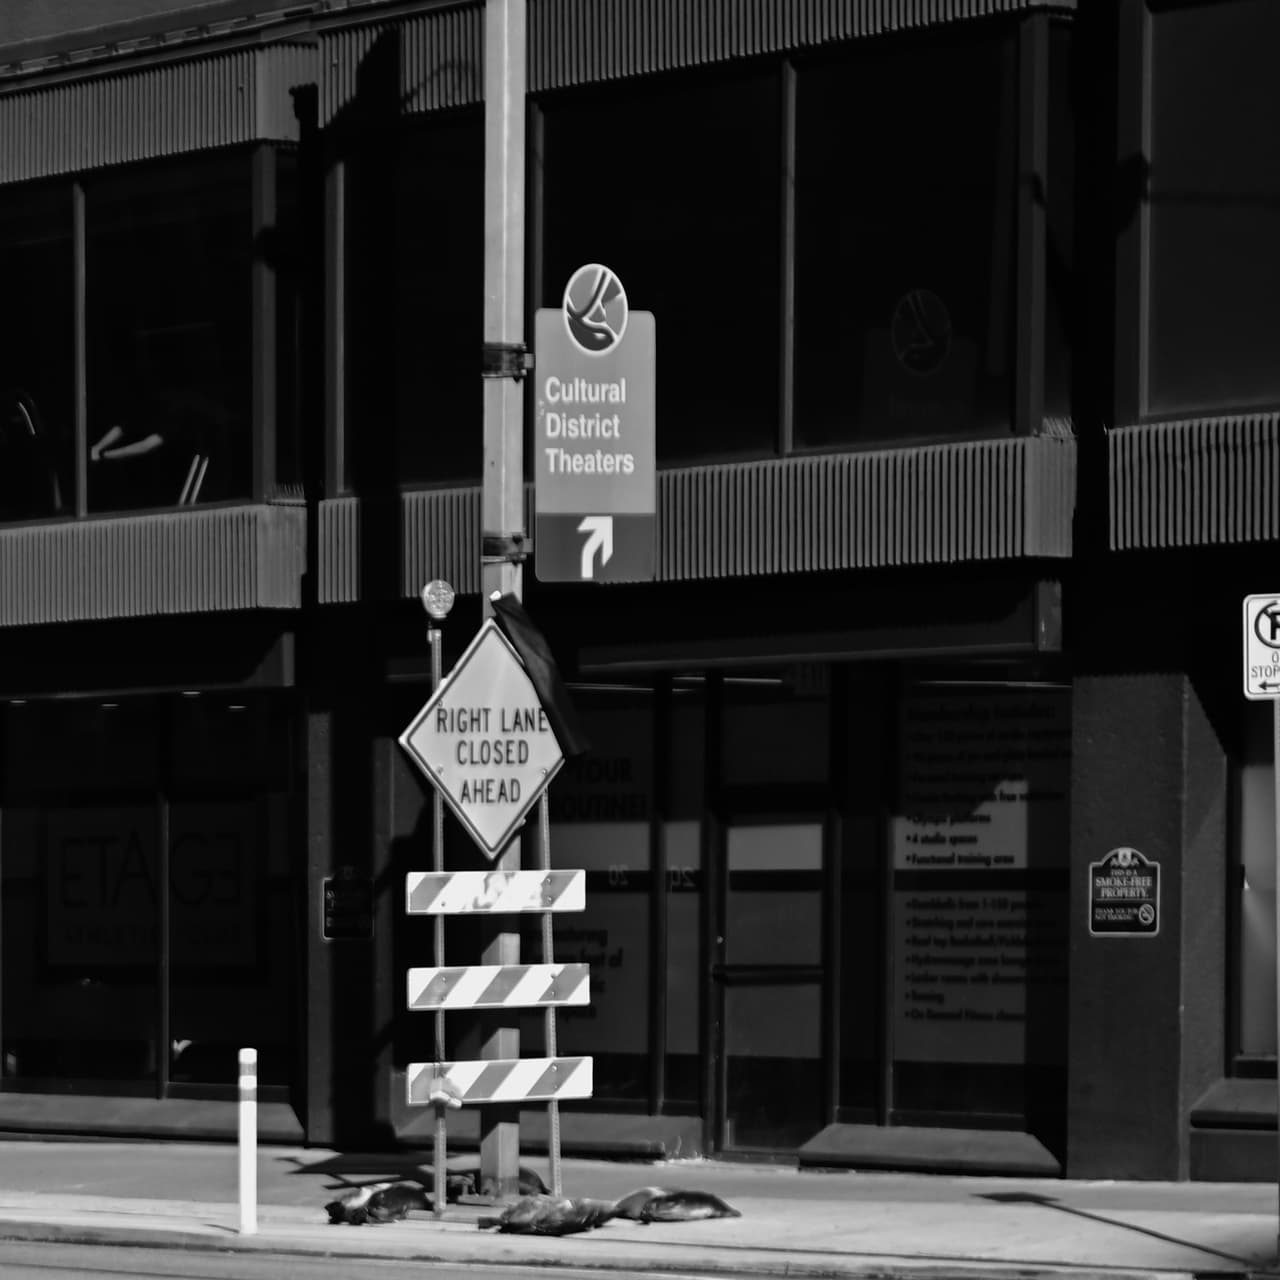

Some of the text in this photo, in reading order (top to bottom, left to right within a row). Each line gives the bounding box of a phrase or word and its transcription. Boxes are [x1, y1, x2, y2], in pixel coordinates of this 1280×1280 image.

[545, 376, 627, 404] Cultural
[545, 411, 621, 439] District
[544, 447, 635, 475] Theaters
[436, 706, 548, 733] RIGHT LANE
[456, 739, 529, 766] CLOSED
[460, 778, 521, 804] AHEAD
[1095, 876, 1153, 887] SMOKE-FREE
